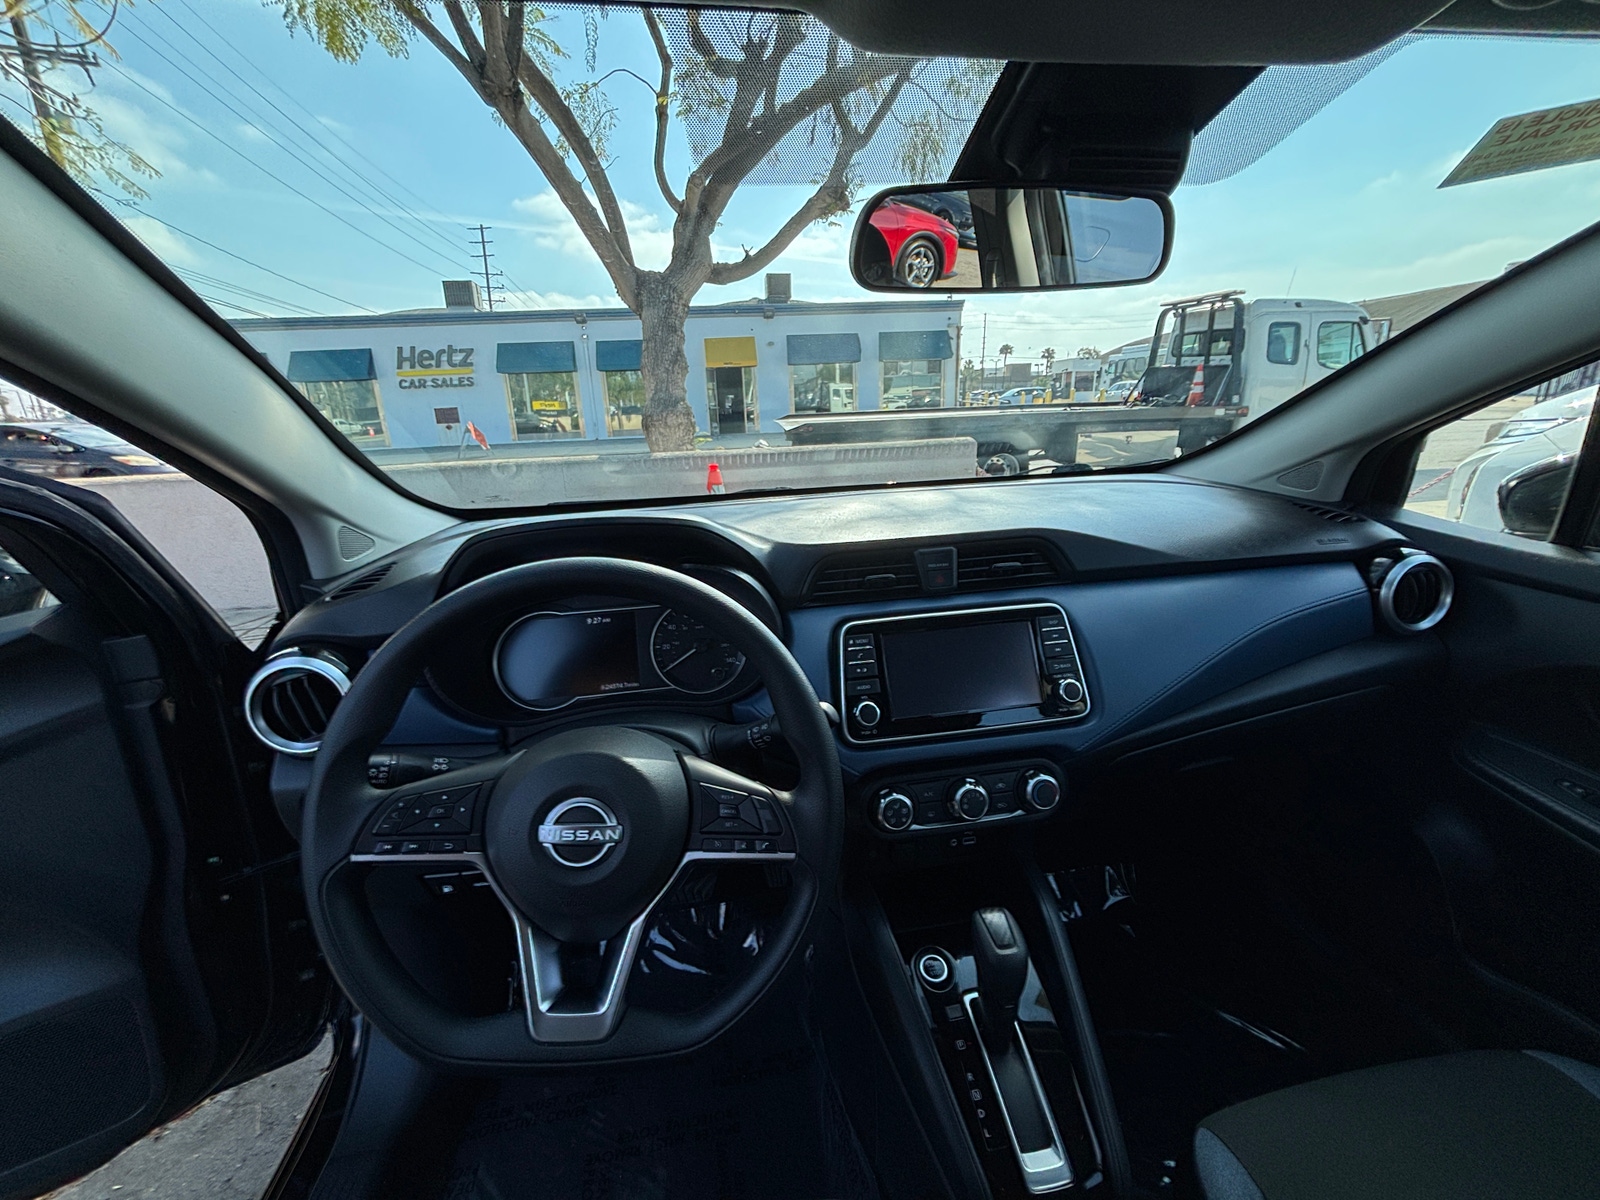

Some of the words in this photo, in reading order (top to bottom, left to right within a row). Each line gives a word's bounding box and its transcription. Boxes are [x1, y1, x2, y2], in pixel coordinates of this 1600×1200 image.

[396, 345, 474, 370] Hertz
[399, 379, 428, 389] CAR
[430, 377, 475, 388] SALES
[540, 829, 620, 841] NISSAN
[977, 1108, 986, 1118] D
[983, 1128, 992, 1138] L
